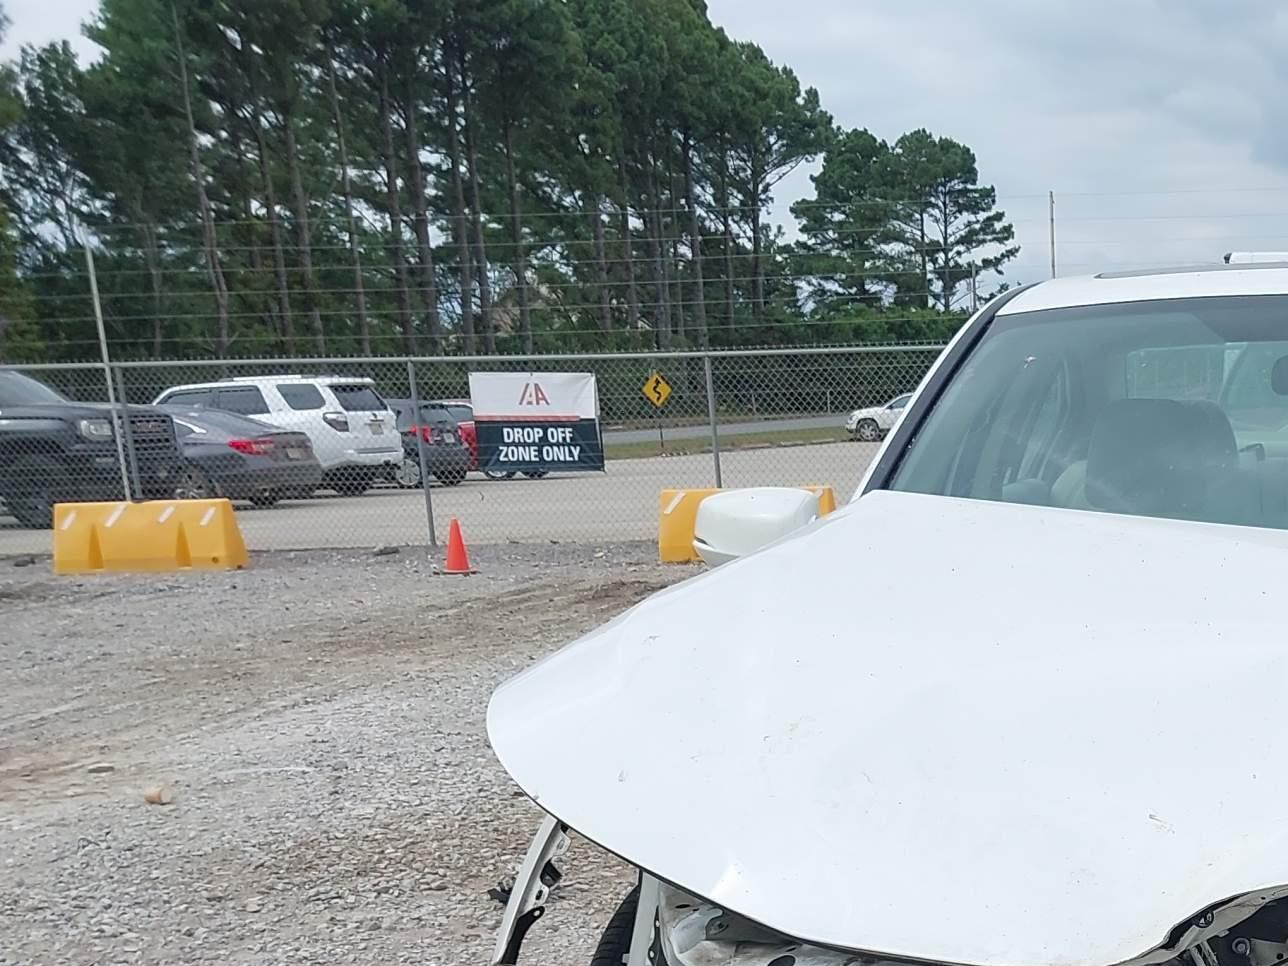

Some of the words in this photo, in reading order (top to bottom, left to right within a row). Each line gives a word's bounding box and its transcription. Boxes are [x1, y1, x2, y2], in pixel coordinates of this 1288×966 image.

[503, 427, 543, 443] DROP
[547, 427, 573, 443] OFF
[499, 446, 540, 462] ZONE
[543, 446, 580, 462] ONLY
